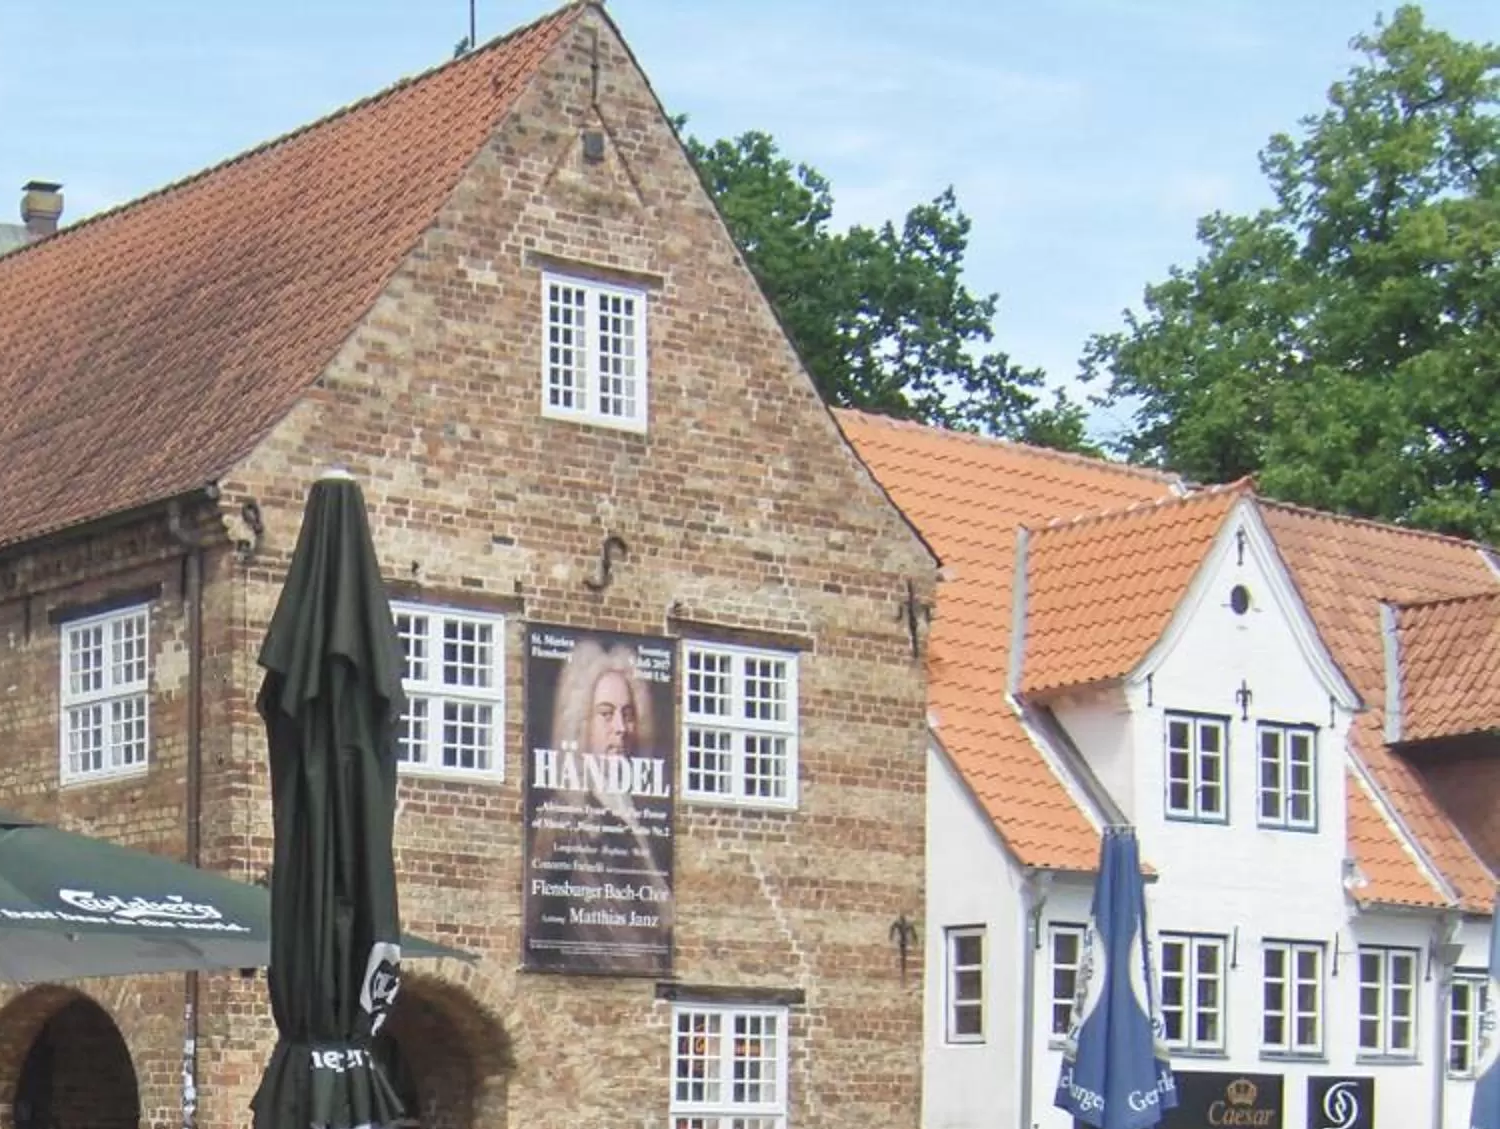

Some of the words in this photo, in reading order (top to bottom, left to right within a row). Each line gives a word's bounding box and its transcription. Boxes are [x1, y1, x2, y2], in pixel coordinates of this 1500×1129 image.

[533, 739, 671, 798] HÄNDEL
[60, 889, 223, 918] Carlsberg
[628, 910, 660, 927] Janz
[1208, 1100, 1276, 1126] Caesar
